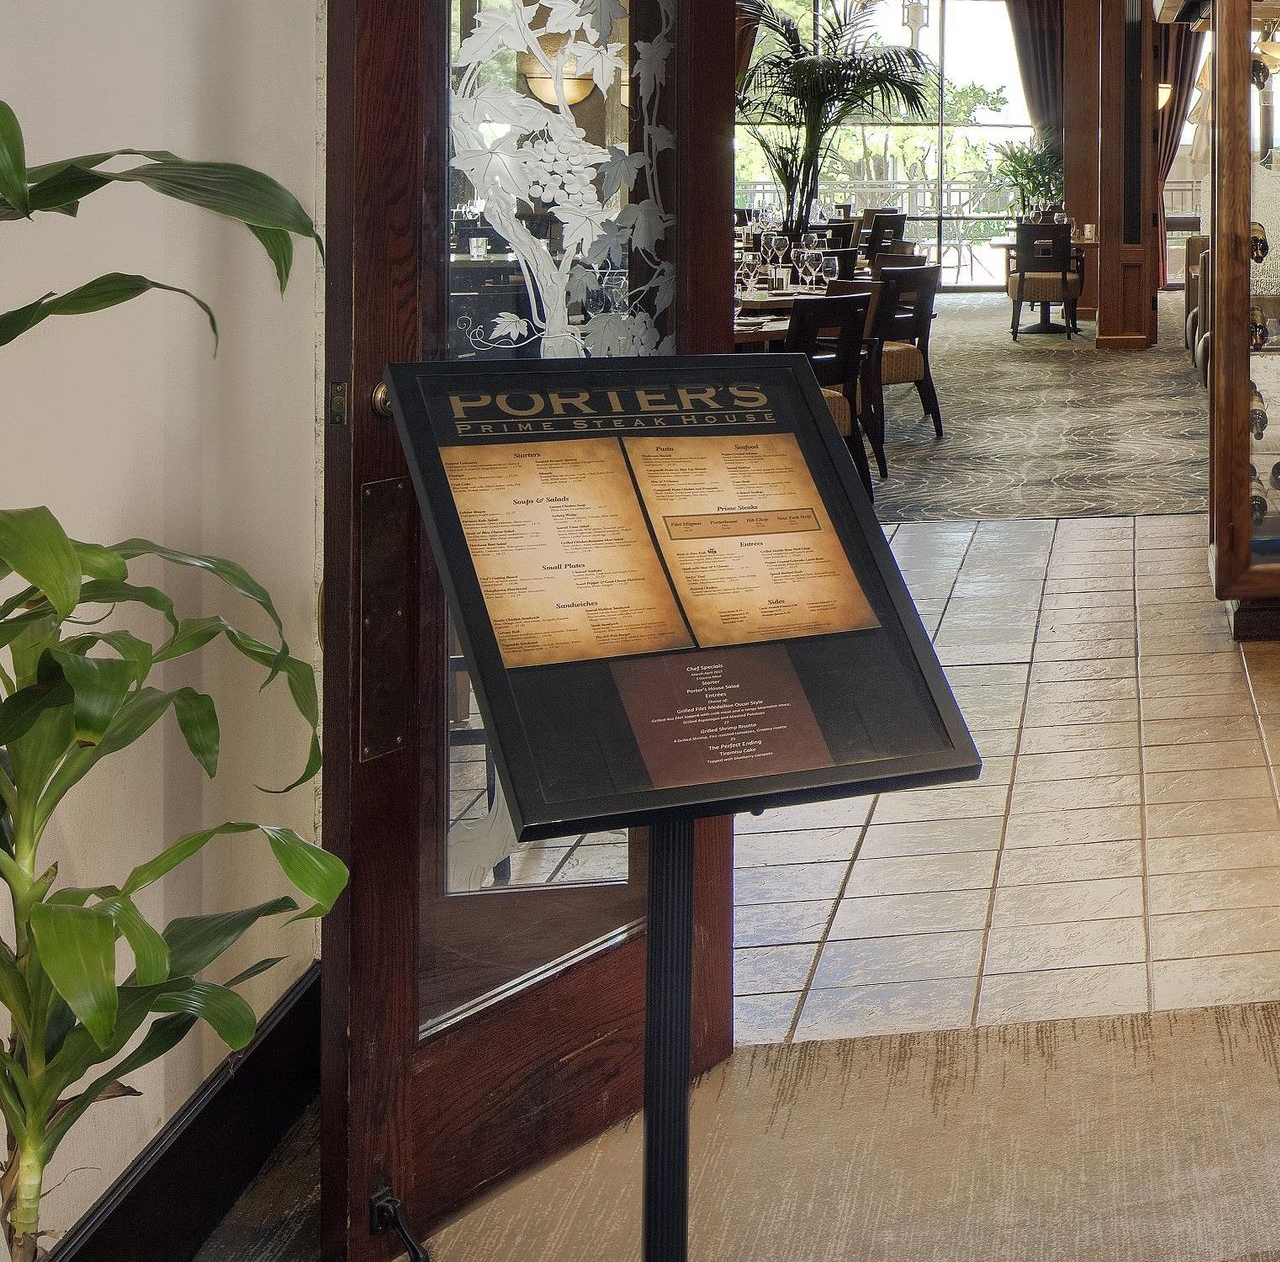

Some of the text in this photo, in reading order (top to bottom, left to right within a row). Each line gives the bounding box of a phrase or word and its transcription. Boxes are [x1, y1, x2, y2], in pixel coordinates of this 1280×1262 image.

[450, 382, 768, 419] PORTER'S
[455, 413, 777, 435] PRIME STEAK HOUSE
[556, 600, 598, 609] Sandwiches
